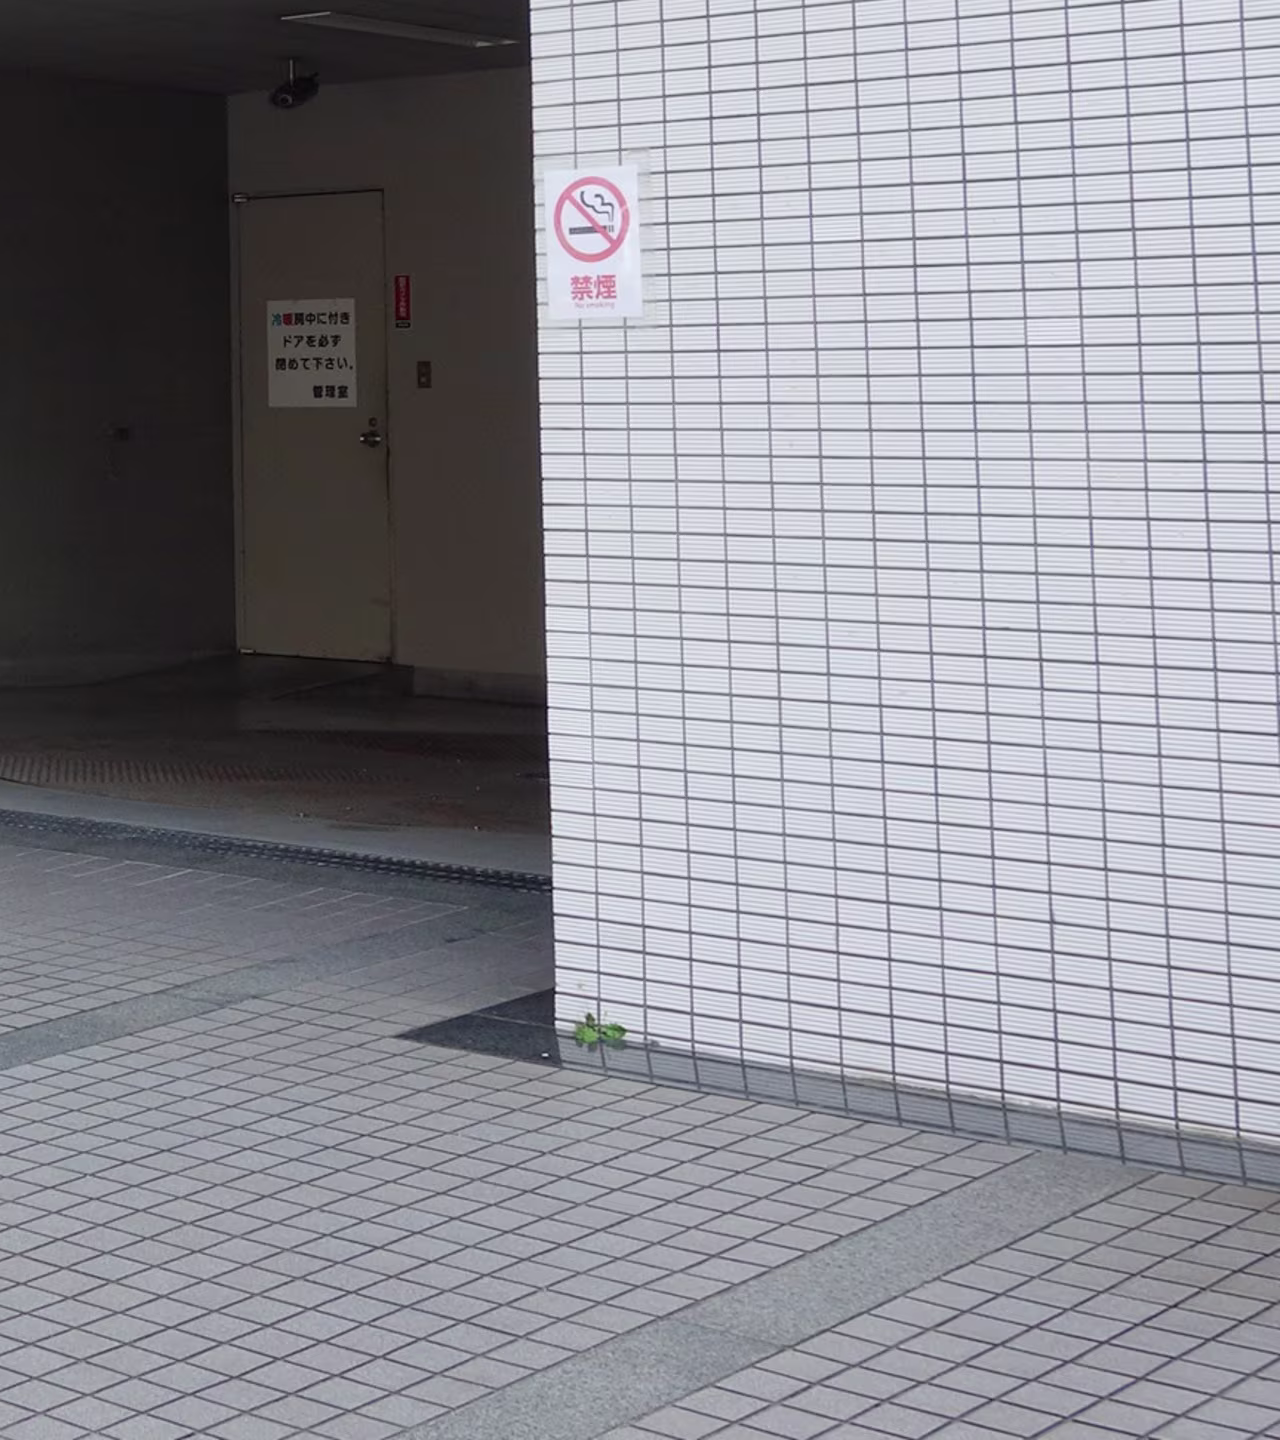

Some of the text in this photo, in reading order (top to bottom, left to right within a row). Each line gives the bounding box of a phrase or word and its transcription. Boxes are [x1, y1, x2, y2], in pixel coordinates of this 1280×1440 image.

[570, 274, 617, 301] 禁煙
[272, 311, 351, 327] 冷暖房中に付き
[282, 334, 342, 348] ドアを必ず
[312, 385, 349, 399] 管理室
